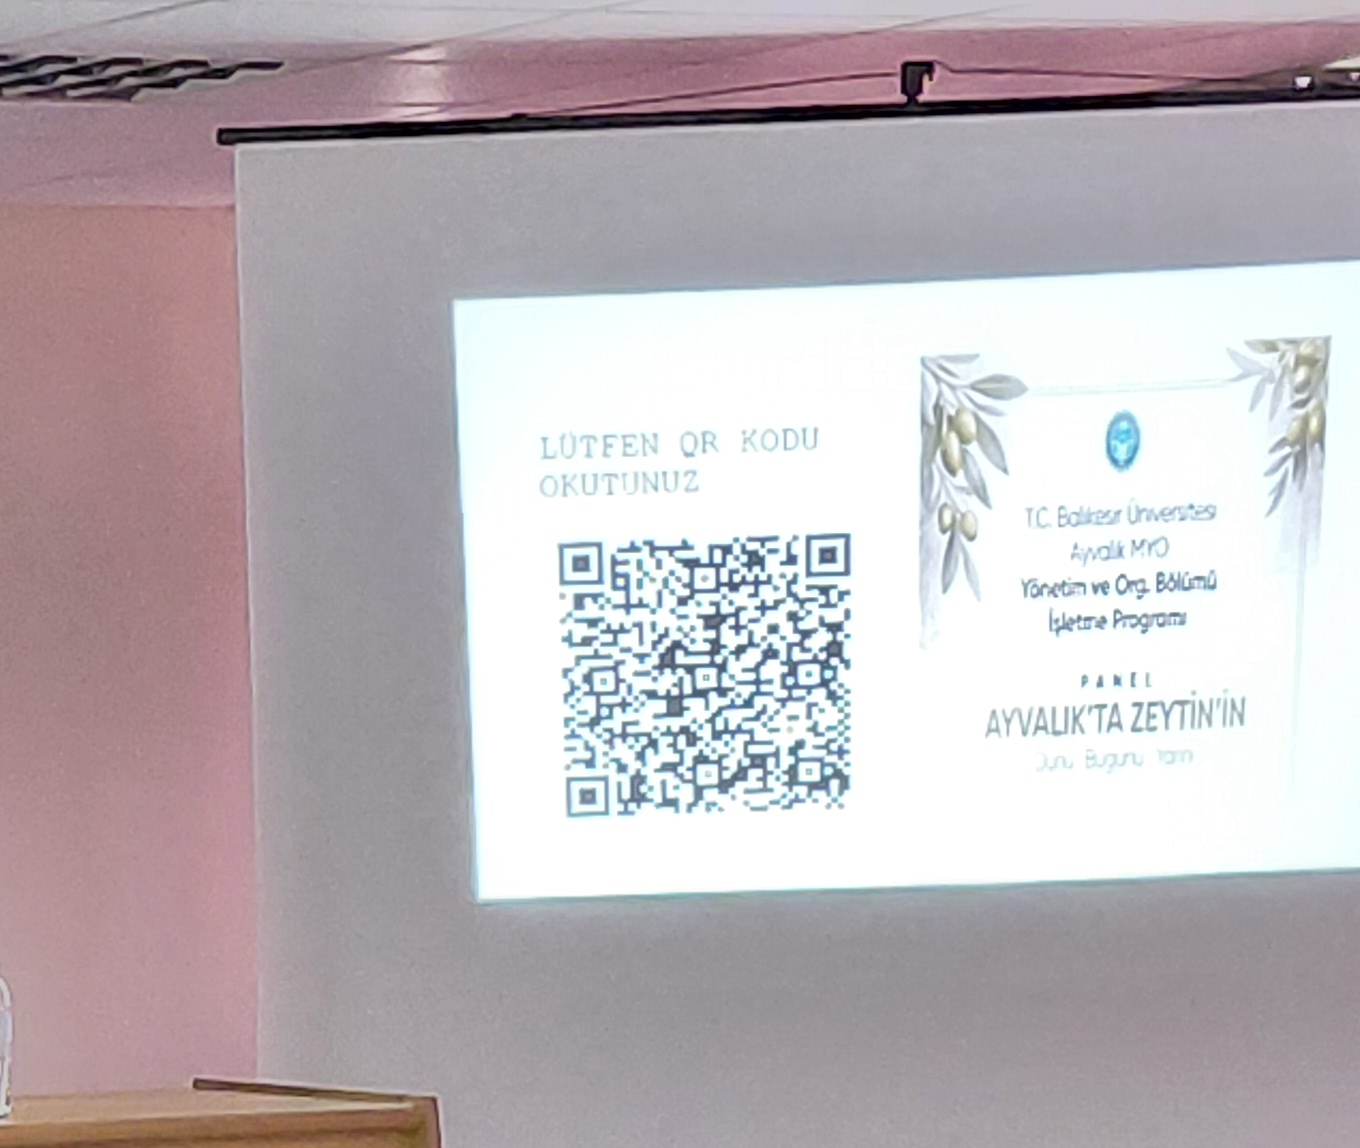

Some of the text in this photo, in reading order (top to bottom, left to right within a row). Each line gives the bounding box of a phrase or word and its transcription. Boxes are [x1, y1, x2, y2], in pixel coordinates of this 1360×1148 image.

[540, 426, 820, 460] LÜTFEN QR KODU
[539, 470, 700, 498] OKUTUNUZ
[1091, 580, 1110, 596] ve
[985, 687, 1246, 739] AYVALIK'TA ZEYTİN'İN
